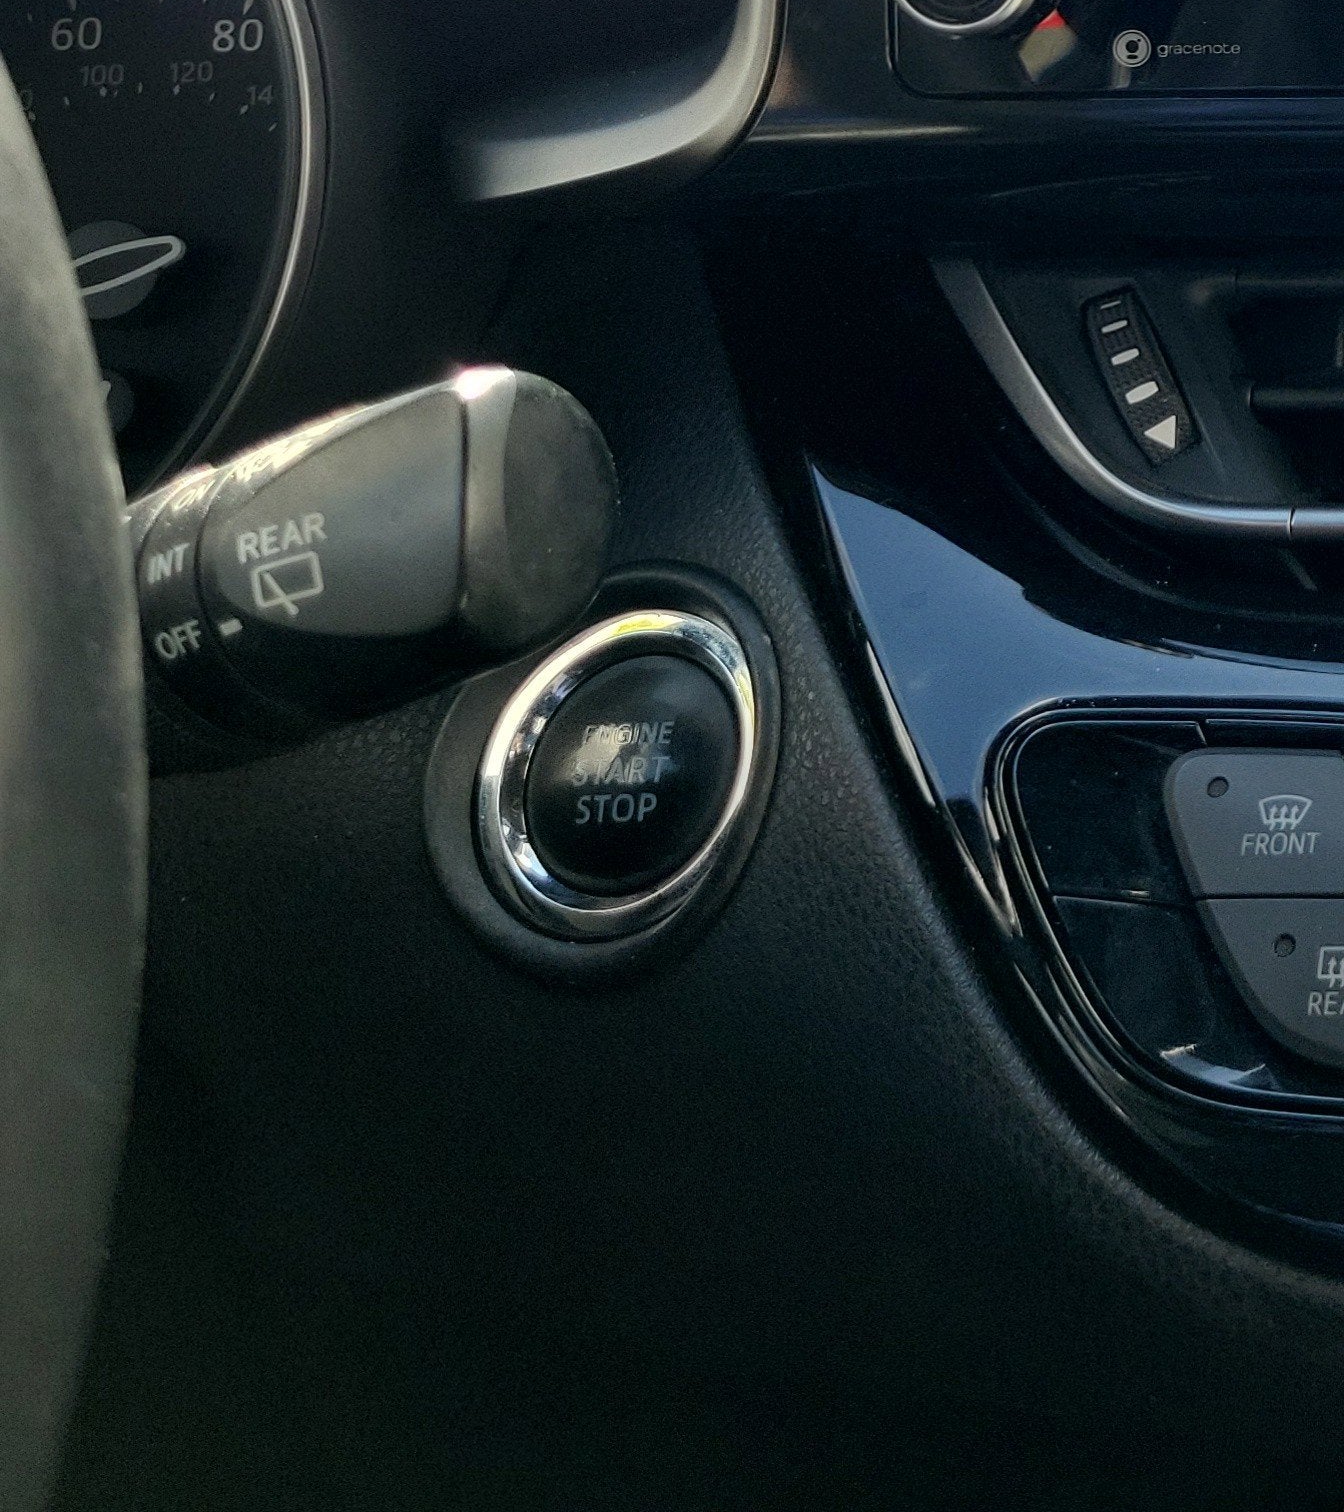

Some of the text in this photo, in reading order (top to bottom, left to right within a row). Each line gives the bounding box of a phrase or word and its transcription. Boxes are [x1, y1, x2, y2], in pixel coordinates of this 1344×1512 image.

[51, 17, 102, 51] 60
[212, 18, 264, 52] 80
[1157, 40, 1241, 57] gracenote
[81, 64, 125, 87] 100
[170, 61, 213, 83] 120
[235, 512, 328, 564] REAR
[147, 542, 191, 586] INT
[153, 619, 201, 660] OFF
[583, 720, 676, 746] ENGINE
[572, 755, 671, 787] START
[574, 793, 658, 825] STOP
[1240, 831, 1321, 856] FRONT
